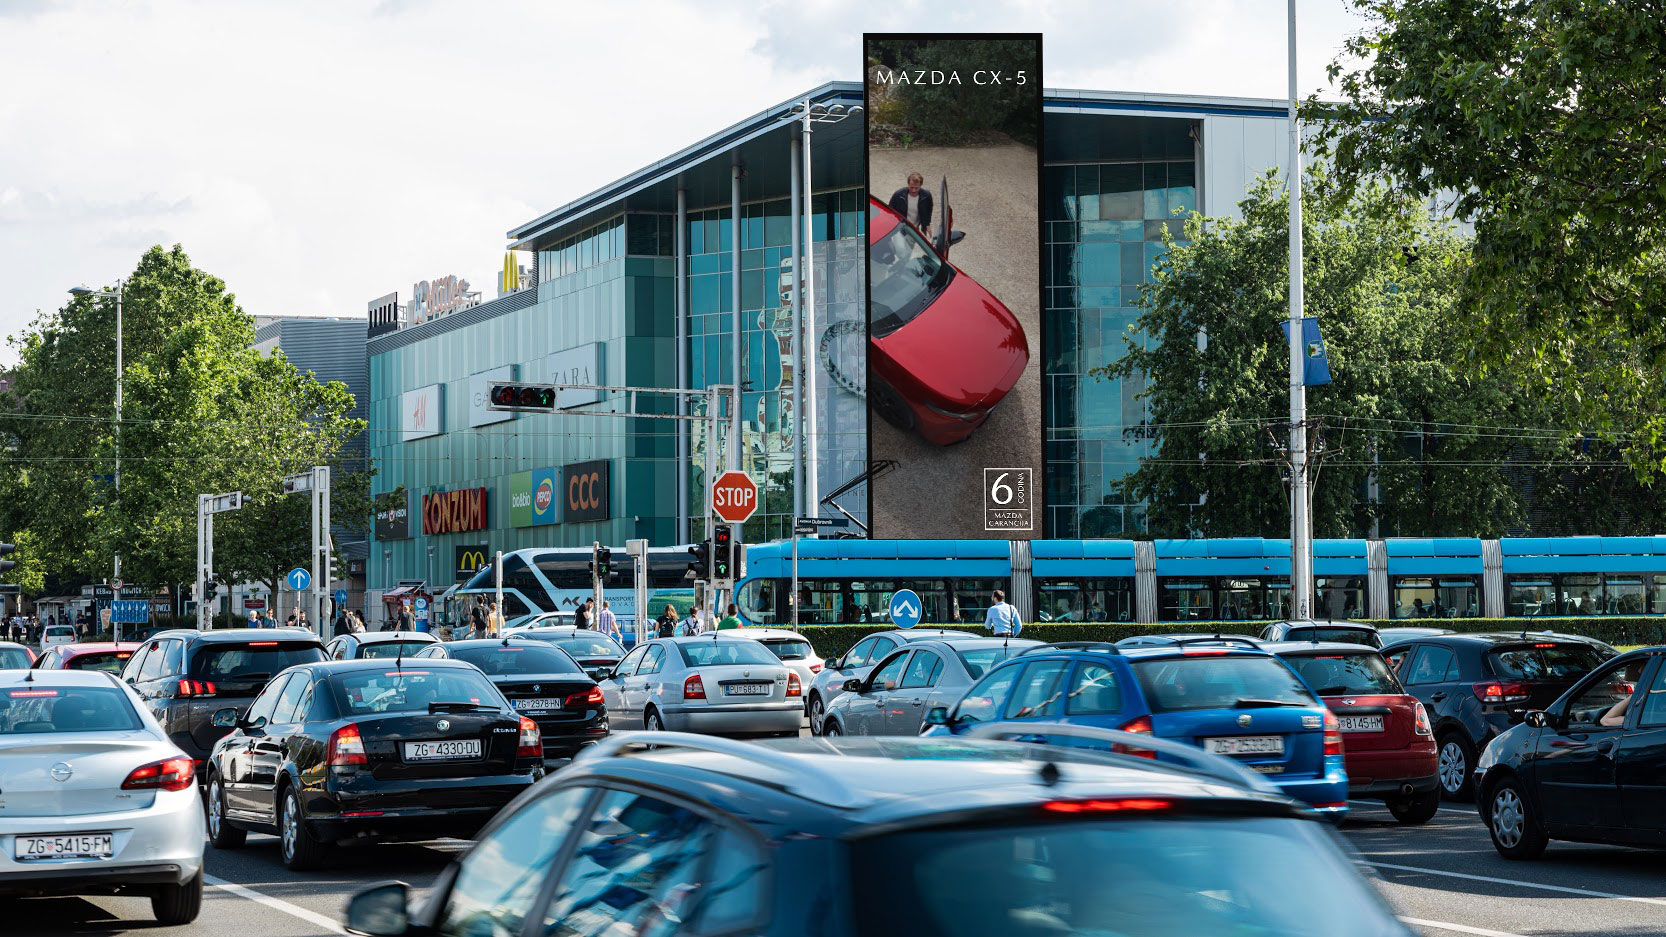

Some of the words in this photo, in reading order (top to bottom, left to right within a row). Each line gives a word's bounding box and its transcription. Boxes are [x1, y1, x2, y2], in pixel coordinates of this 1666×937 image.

[876, 70, 962, 85] MAZDA
[973, 70, 1027, 85] CX-5
[569, 472, 599, 511] CCC
[715, 487, 754, 507] STOP
[991, 472, 1013, 505] 6
[1017, 472, 1025, 504] GODINA
[512, 491, 531, 508] bio&bio
[422, 487, 482, 535] KONZUM
[516, 700, 527, 709] ZG
[414, 743, 429, 757] ZG
[27, 839, 45, 855] ZG
